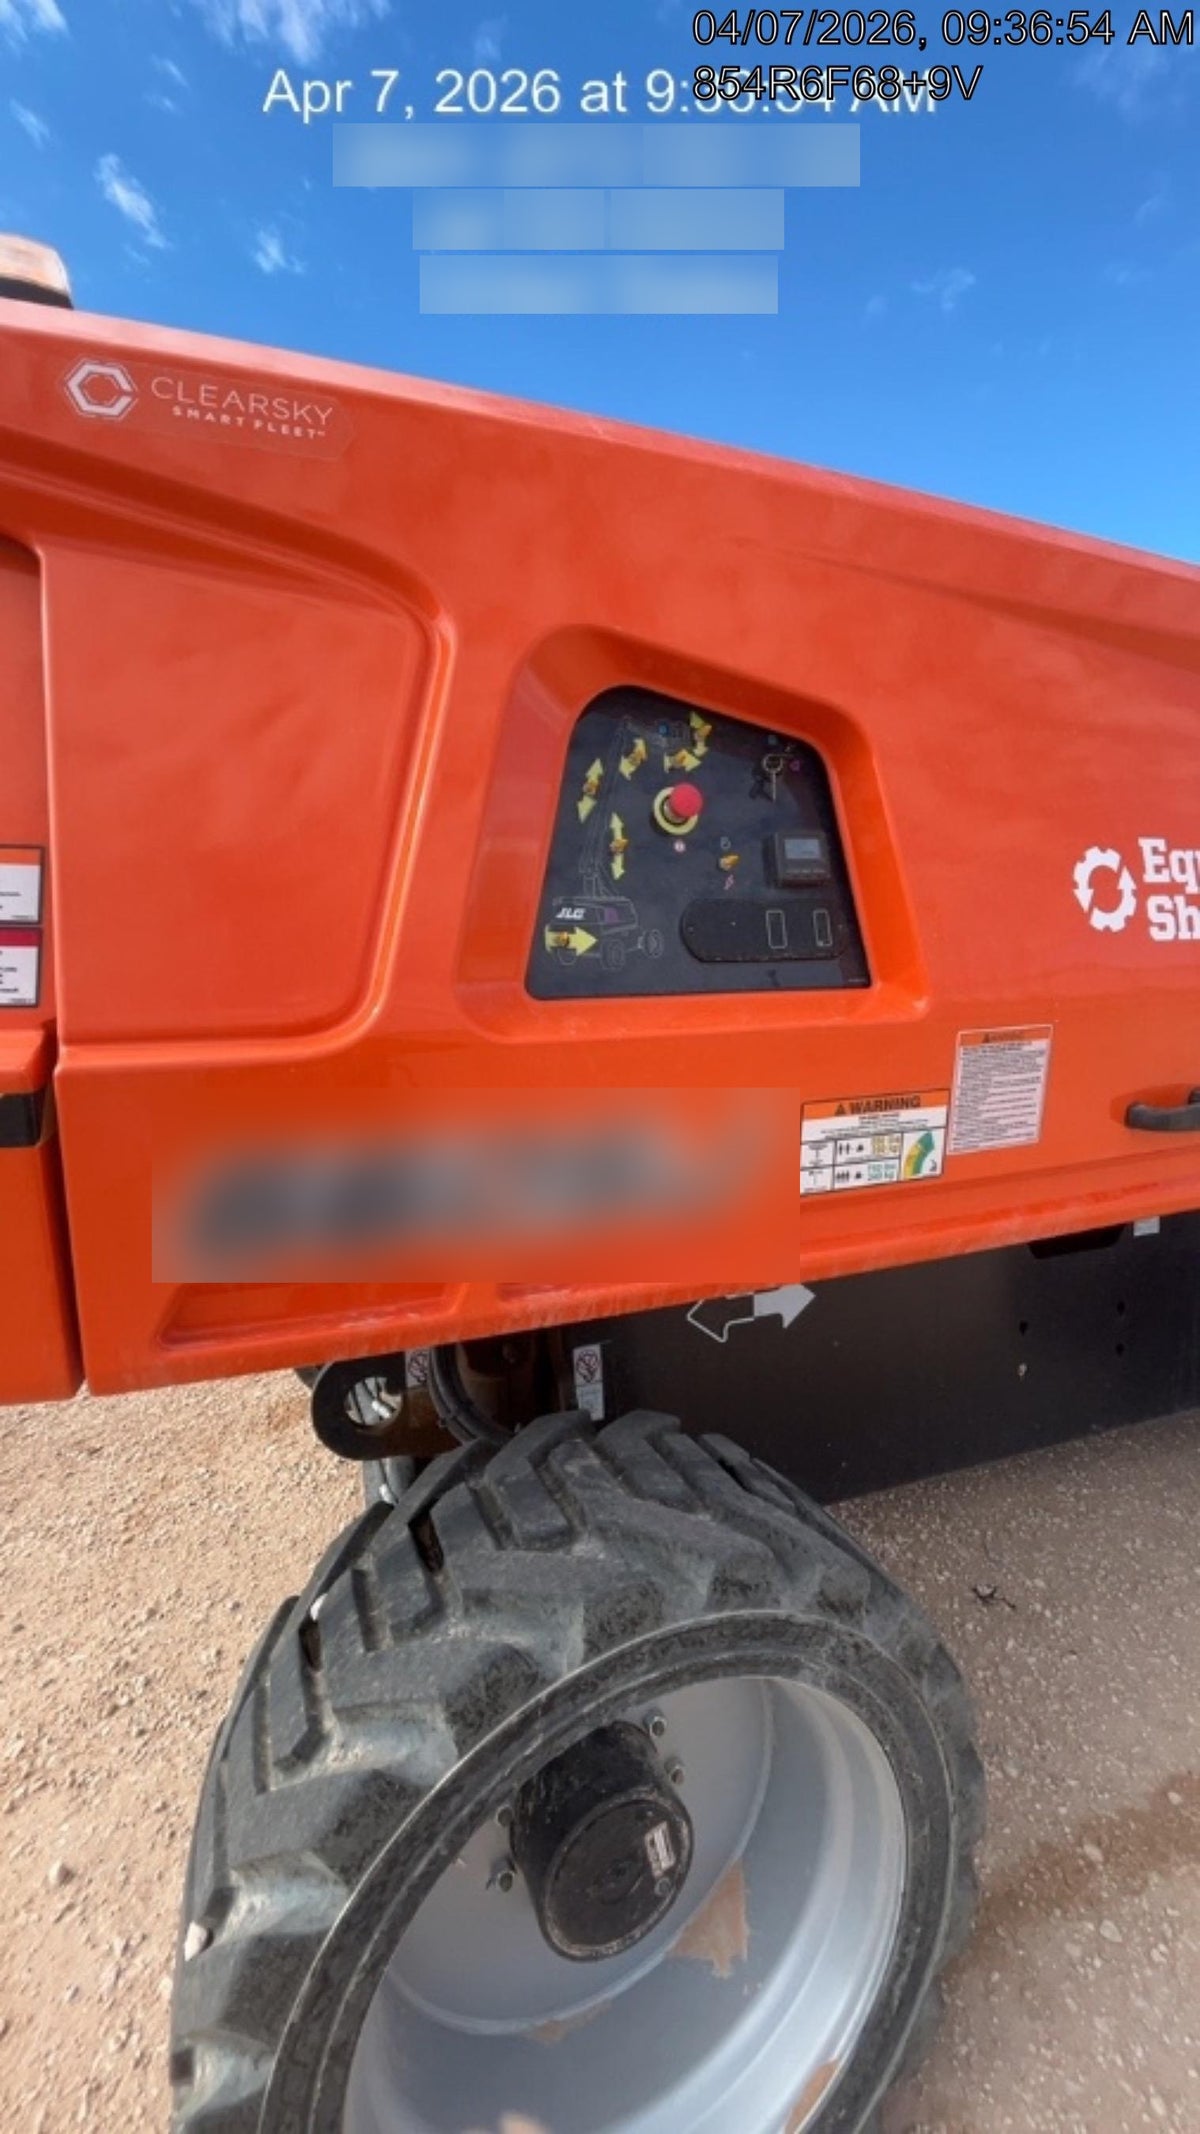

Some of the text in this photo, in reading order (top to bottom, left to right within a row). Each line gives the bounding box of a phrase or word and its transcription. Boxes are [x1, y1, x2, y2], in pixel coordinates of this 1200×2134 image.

[151, 376, 333, 425] CLEARSKY
[172, 405, 246, 427] SMART
[1138, 836, 1200, 894] Eq
[848, 1095, 921, 1115] WARNING
